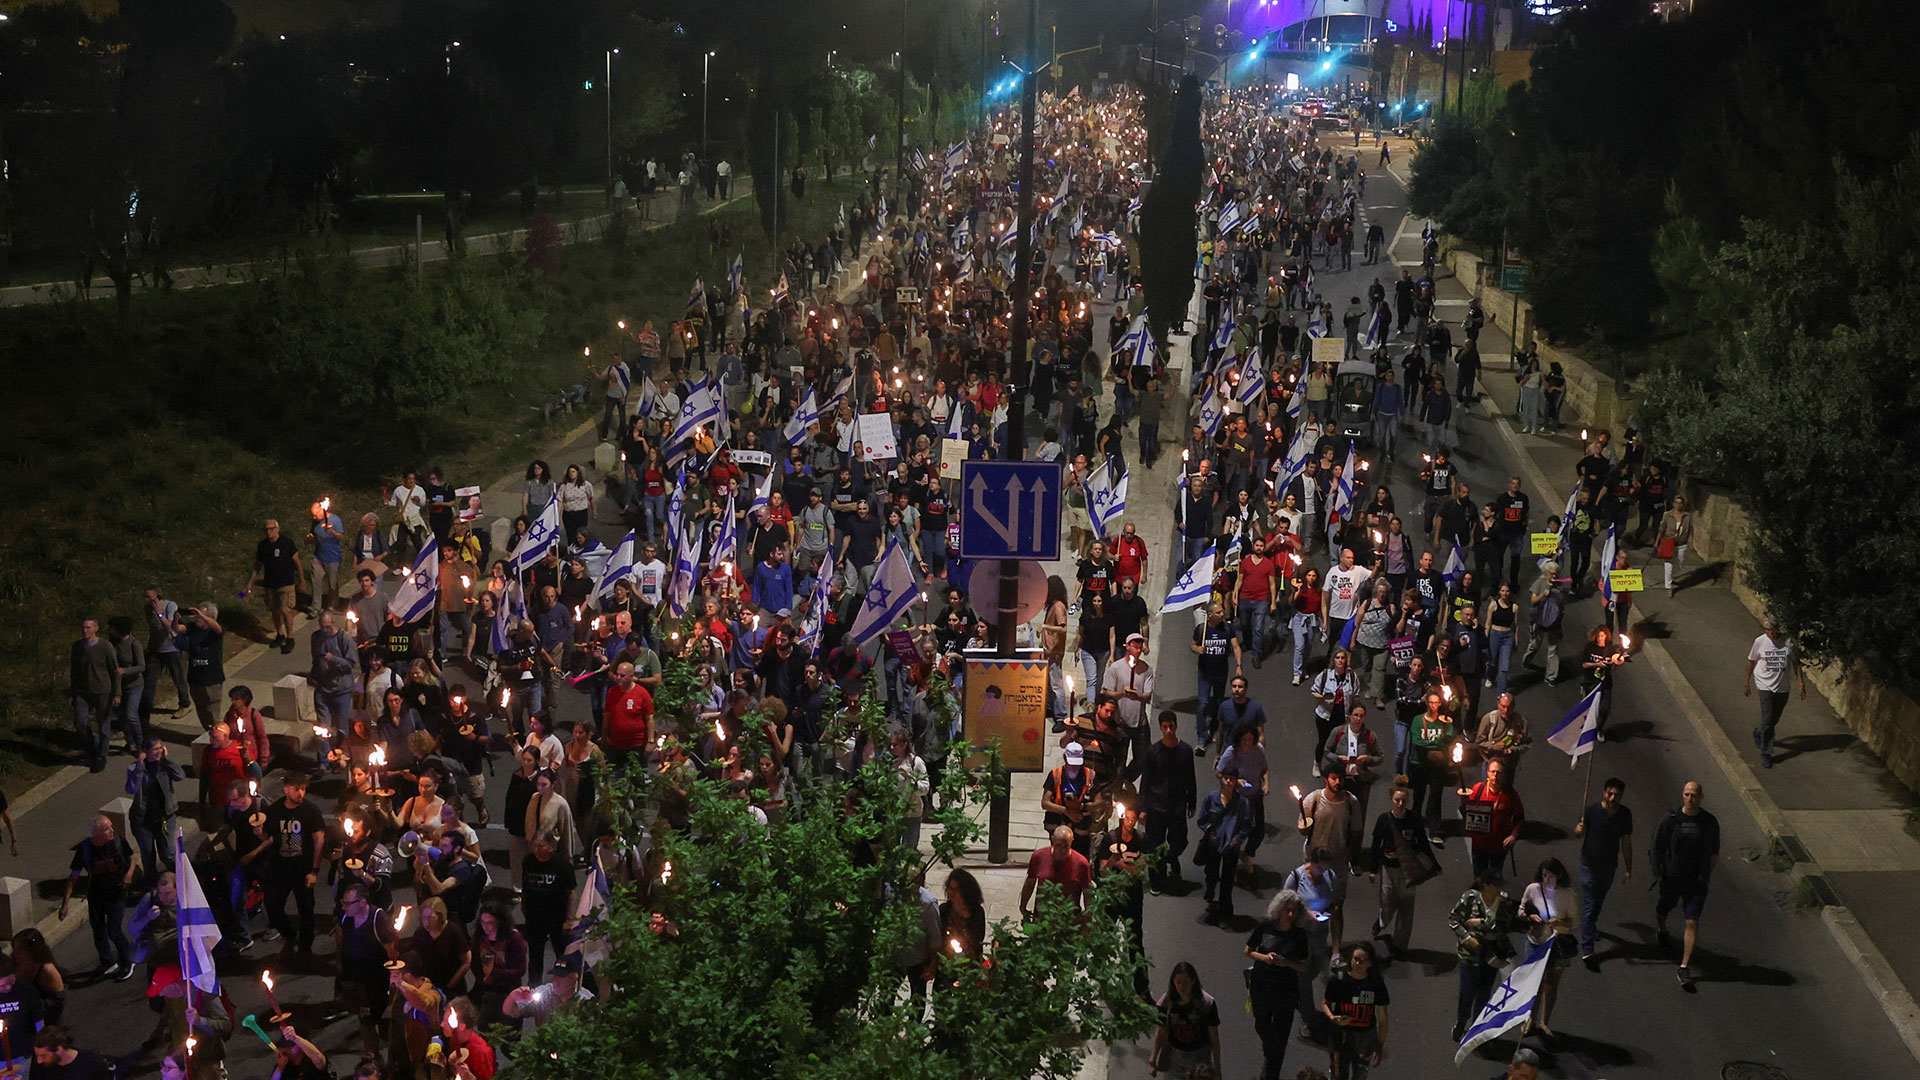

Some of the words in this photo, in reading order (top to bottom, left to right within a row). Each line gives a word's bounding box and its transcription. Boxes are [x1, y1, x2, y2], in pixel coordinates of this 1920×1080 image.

[1395, 649, 1414, 658] נגד
[1020, 685, 1042, 693] פורים
[1004, 694, 1042, 704] בתיאטרון
[1018, 703, 1042, 715] הקרון
